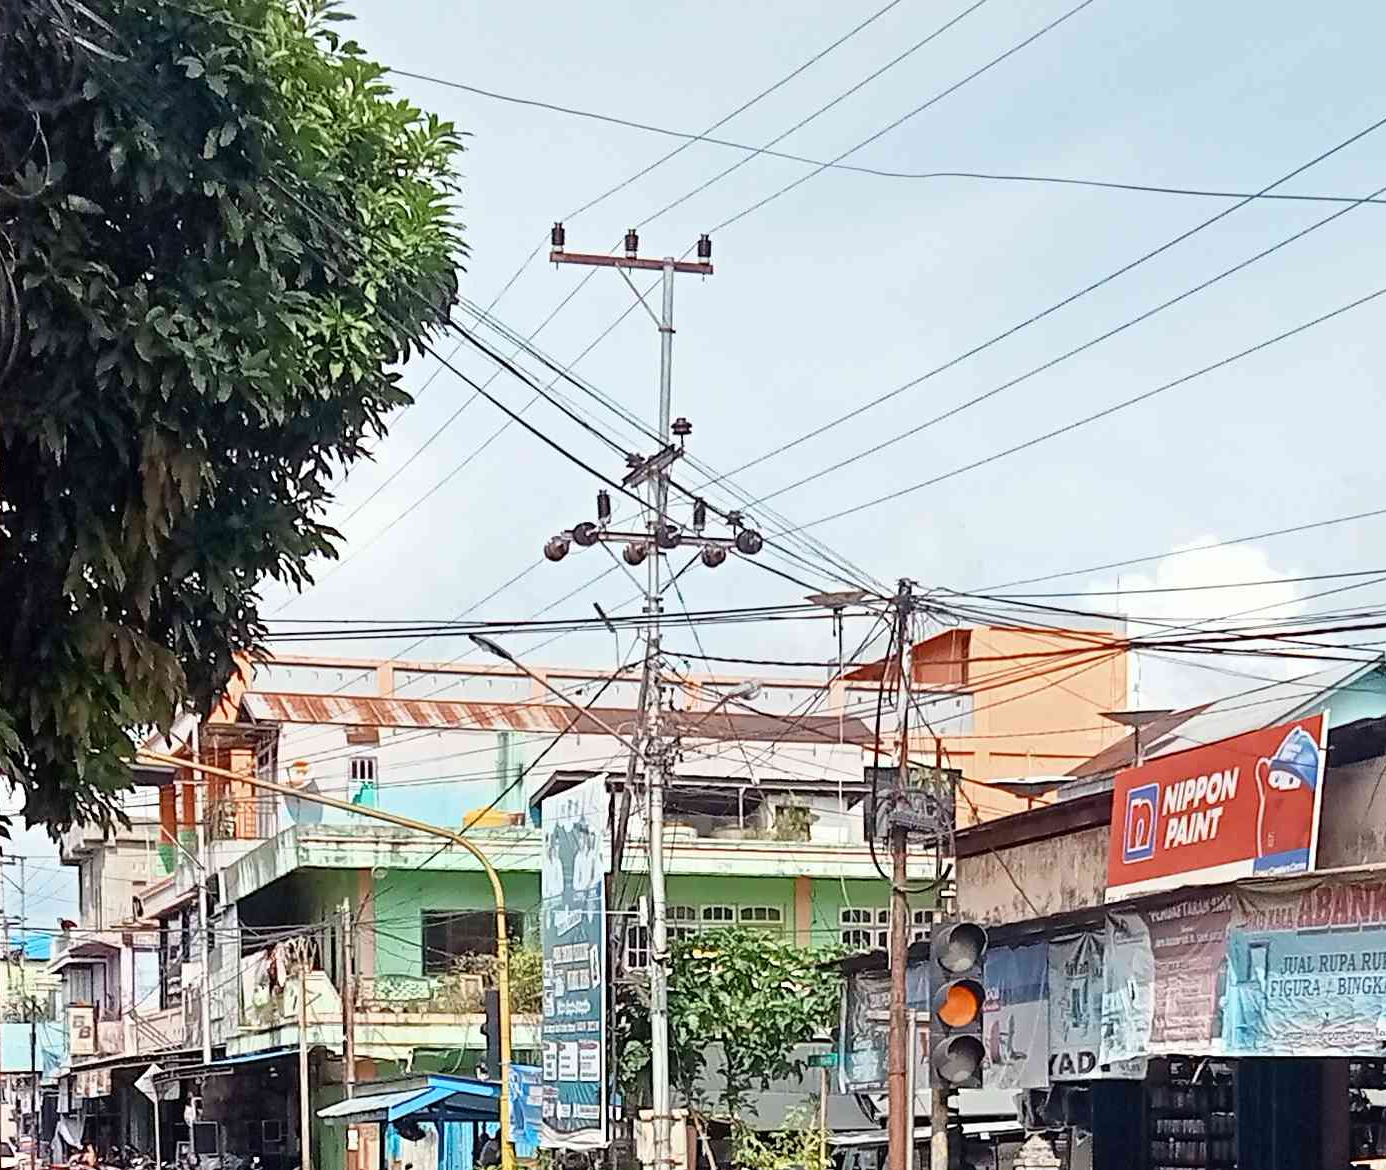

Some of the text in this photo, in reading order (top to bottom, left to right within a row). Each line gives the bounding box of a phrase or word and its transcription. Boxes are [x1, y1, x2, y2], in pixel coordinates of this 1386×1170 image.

[1162, 767, 1240, 816] NIPPON
[1164, 806, 1223, 849] PAINT
[1280, 956, 1315, 975] JUAL
[1318, 953, 1358, 972] RUPA
[1270, 978, 1321, 997] FIGURA
